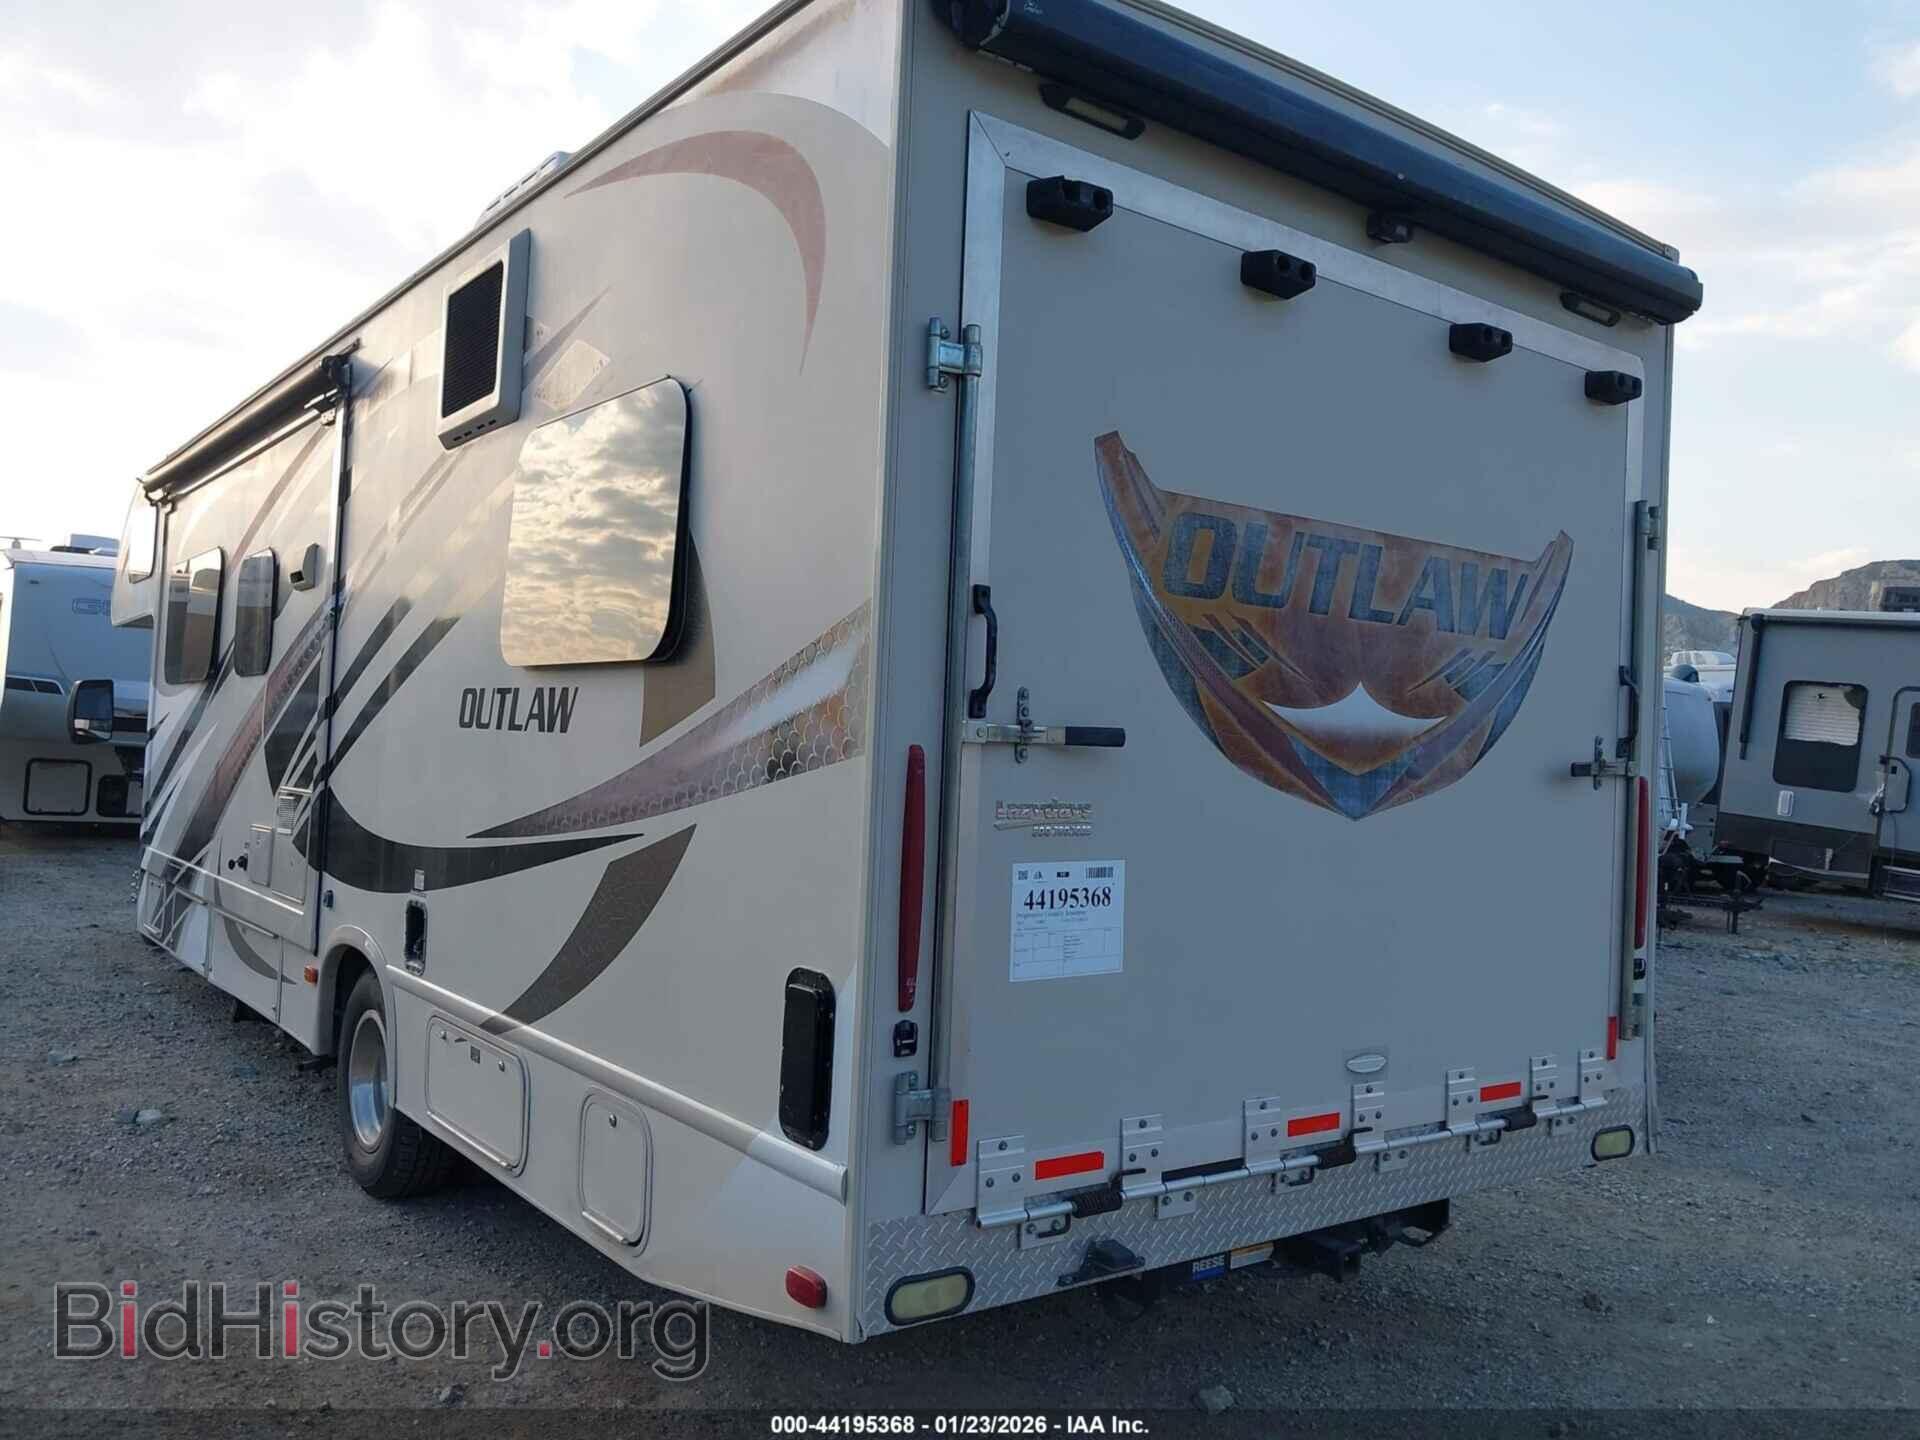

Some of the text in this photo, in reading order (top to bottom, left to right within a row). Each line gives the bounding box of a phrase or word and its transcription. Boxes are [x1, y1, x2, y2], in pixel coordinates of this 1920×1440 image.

[1163, 511, 1530, 641] OUTLAW
[458, 685, 580, 734] OUTLAW
[1023, 886, 1112, 911] 44195368
[1192, 1255, 1225, 1273] REESE
